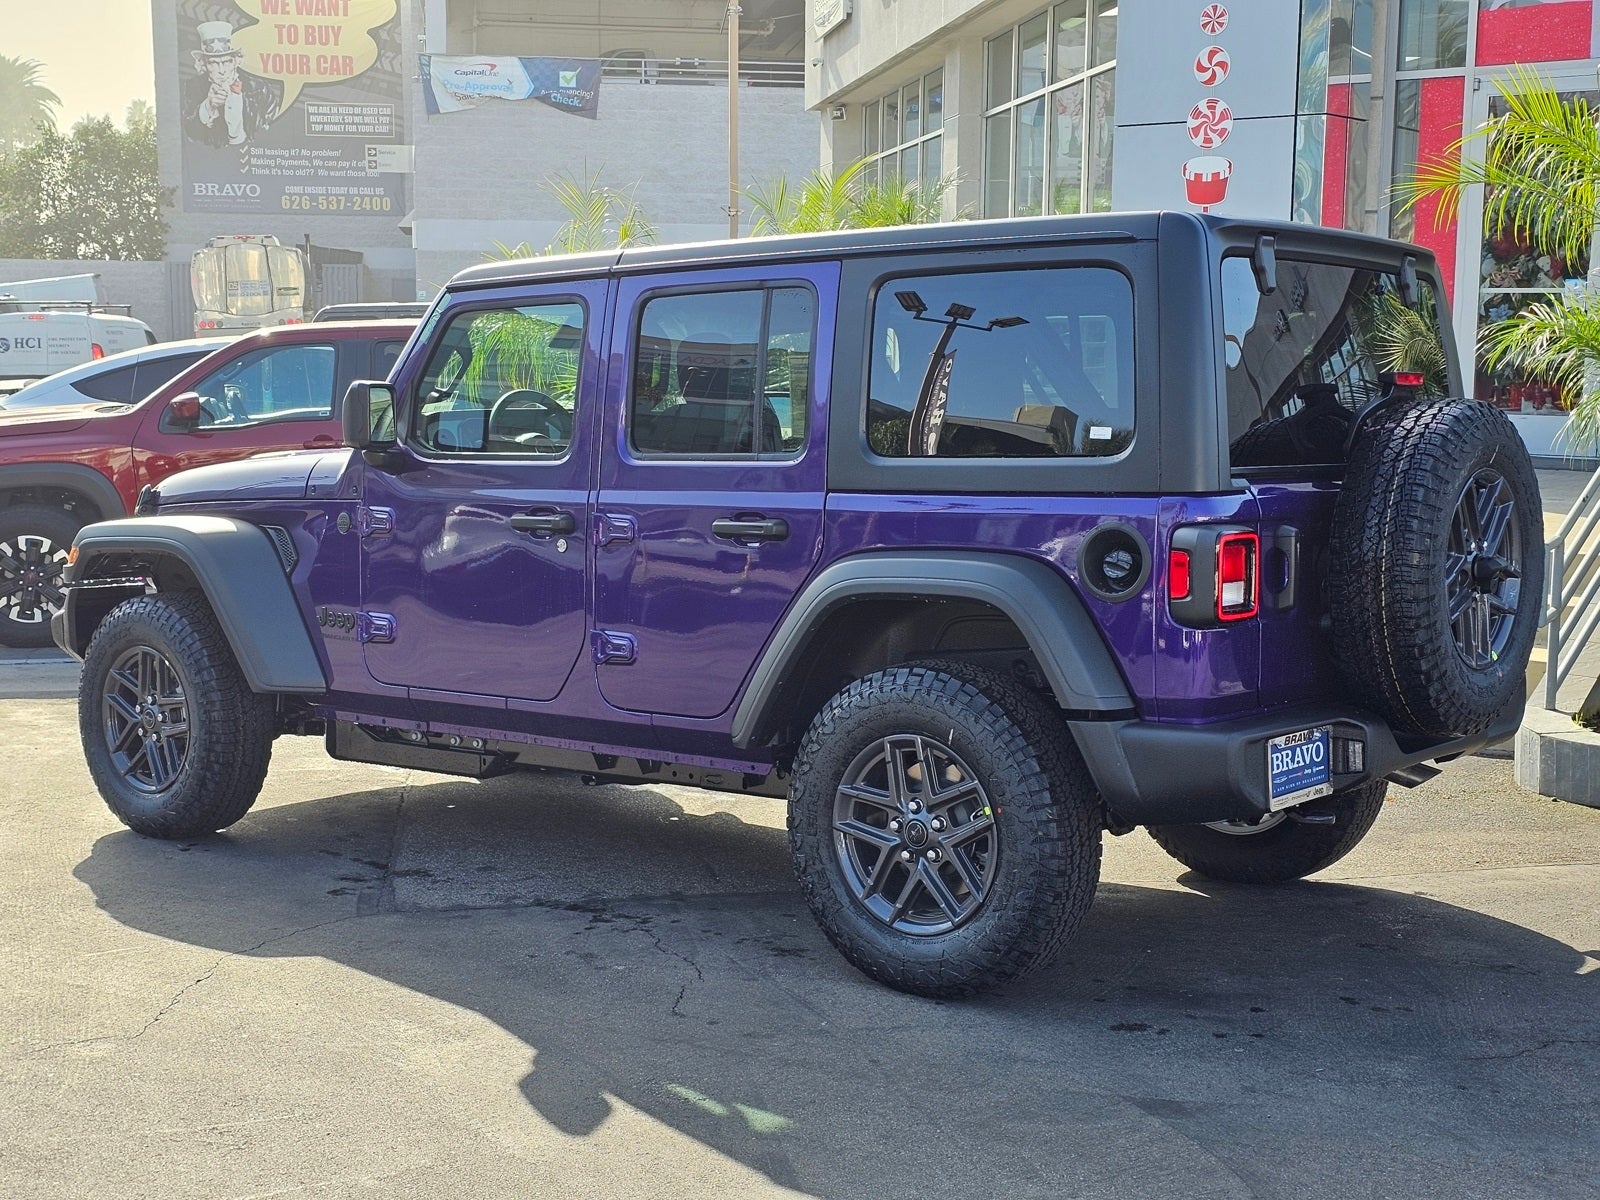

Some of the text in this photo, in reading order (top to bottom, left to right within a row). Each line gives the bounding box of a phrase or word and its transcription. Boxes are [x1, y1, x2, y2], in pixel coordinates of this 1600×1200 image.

[261, 0, 349, 17] WE WANT
[274, 24, 342, 46] TO BUY
[260, 53, 353, 76] YOUR CAR
[550, 93, 582, 107] Check.
[319, 106, 330, 114] ARE
[331, 106, 338, 114] IN
[339, 106, 353, 114] NEED
[379, 107, 392, 115] CAR
[364, 116, 378, 124] WILL
[311, 124, 323, 132] TOP
[323, 124, 345, 132] MONEY
[357, 125, 374, 133] YOUR
[250, 147, 263, 155] Still
[264, 148, 290, 157] leasing
[290, 148, 300, 156] it?
[311, 149, 342, 157] problem!
[250, 158, 275, 167] Making
[276, 158, 311, 167] Payments,
[337, 160, 350, 168] pay
[351, 159, 357, 167] it
[282, 168, 294, 176] too
[295, 168, 315, 176] old??
[192, 183, 261, 197] BRAVO
[285, 185, 304, 193] COME
[304, 186, 327, 194] INSIDE
[327, 186, 348, 194] TODAY
[359, 187, 375, 195] CALL
[375, 187, 385, 195] US
[281, 195, 391, 211] 626-537-2400
[14, 337, 42, 349] HCI
[316, 606, 355, 633] Jeep
[1284, 729, 1314, 746] BRAVO
[1272, 741, 1324, 774] BRAVO
